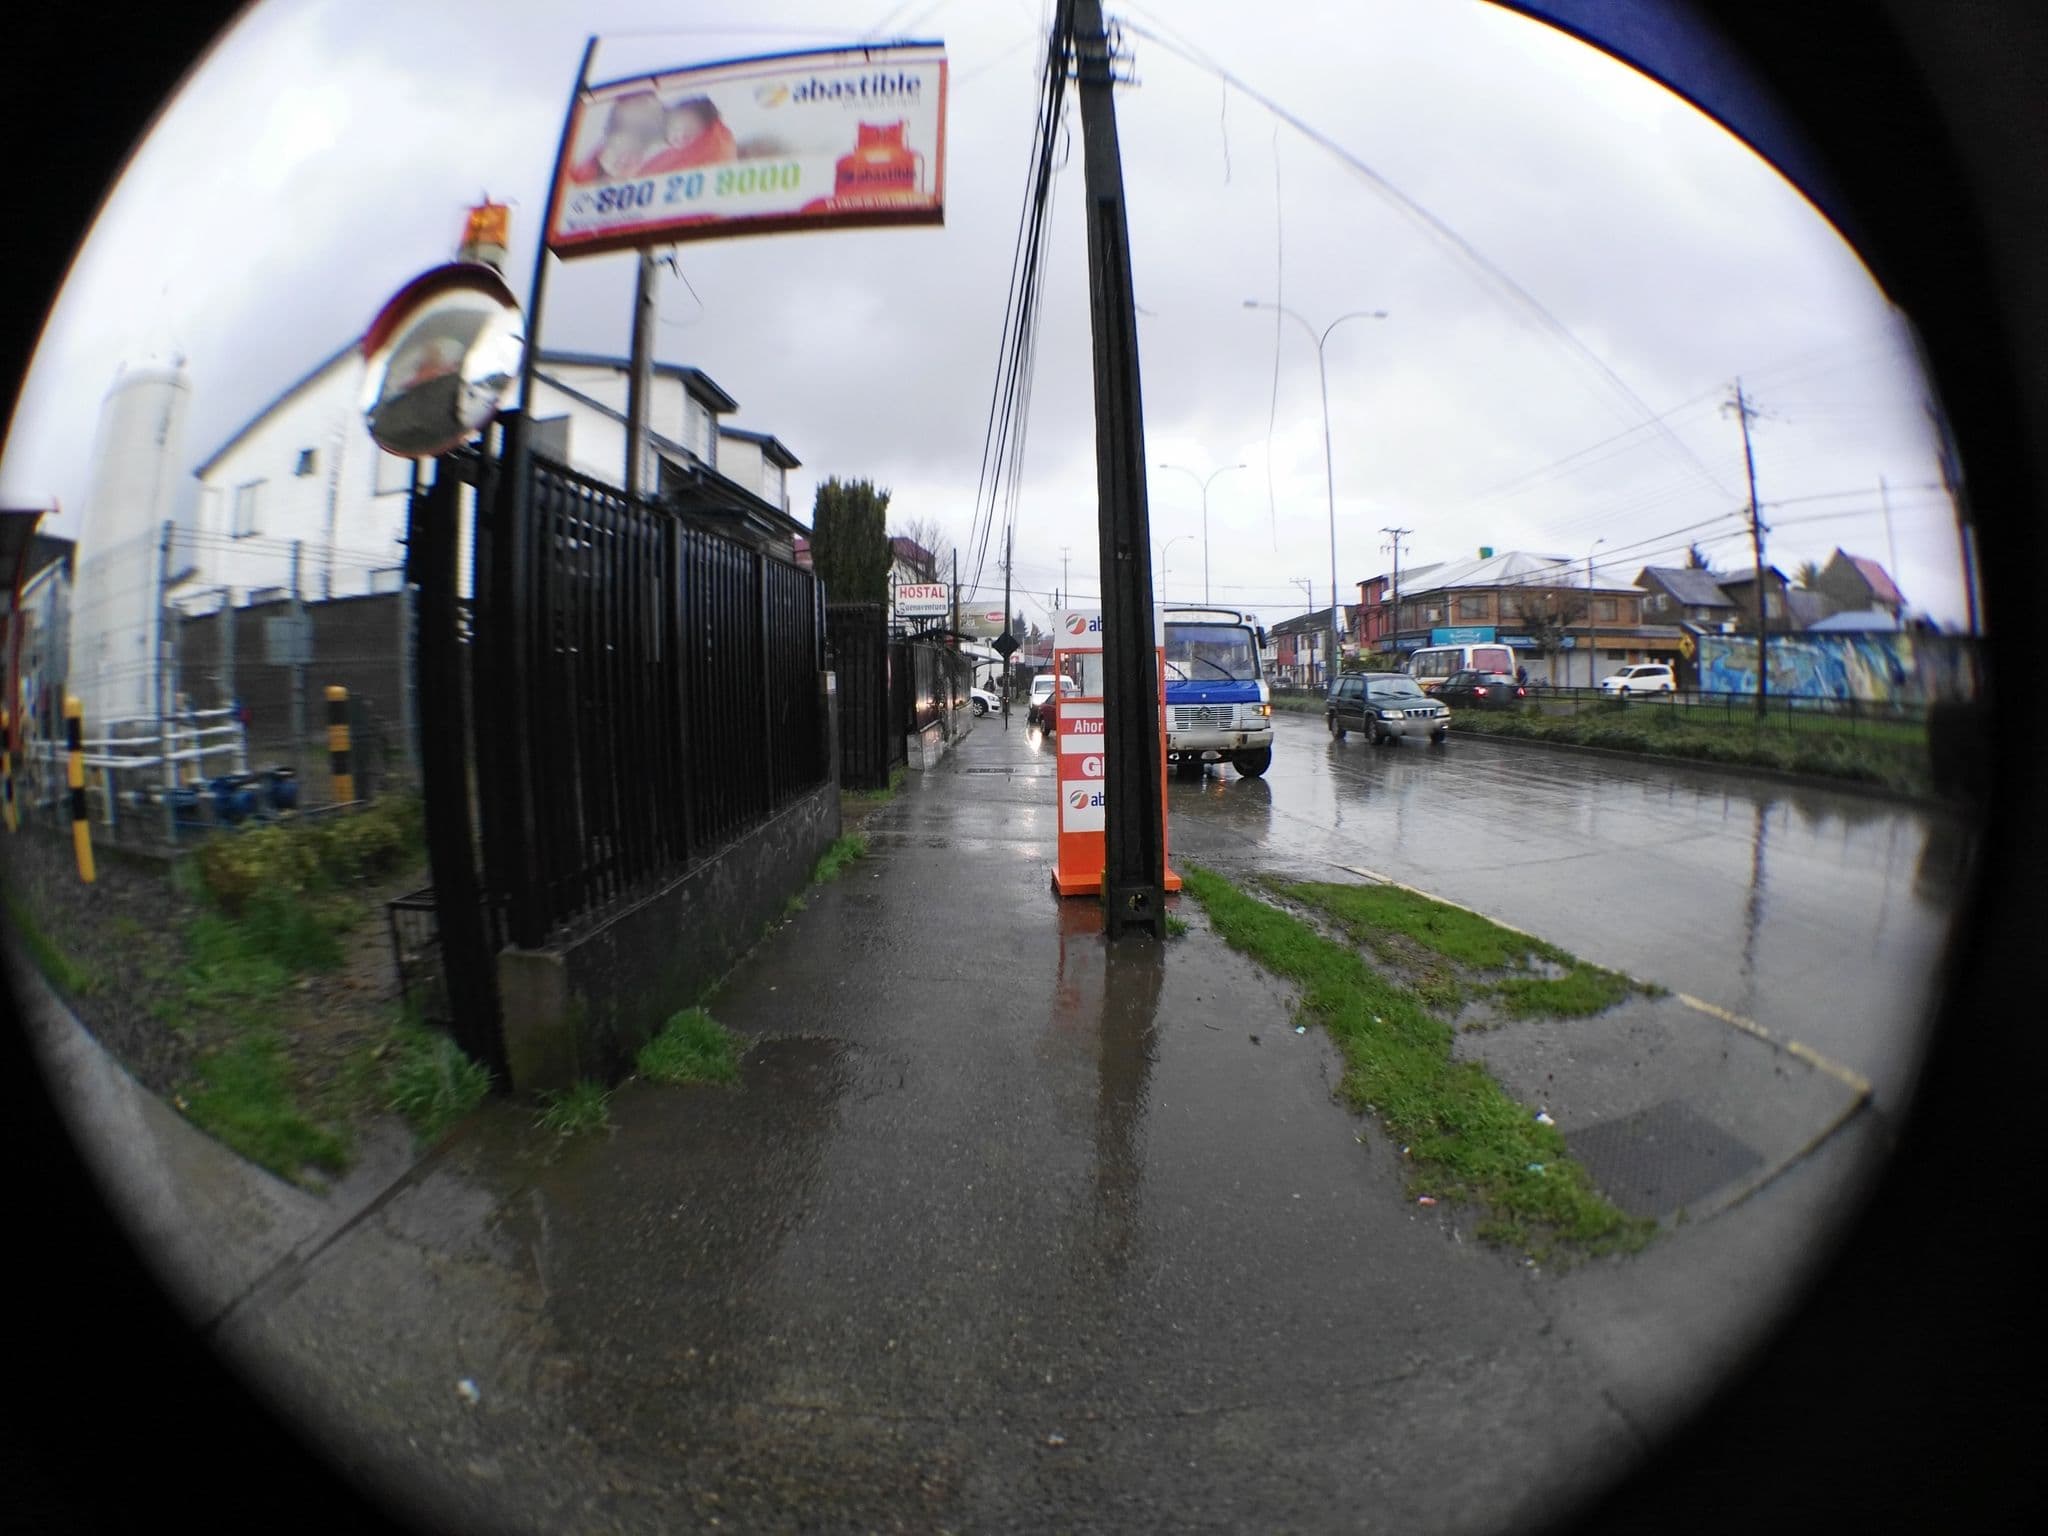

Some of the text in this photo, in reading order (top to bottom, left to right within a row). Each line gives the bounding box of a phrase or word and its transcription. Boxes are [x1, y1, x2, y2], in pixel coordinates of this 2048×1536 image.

[793, 73, 921, 102] abastible
[597, 179, 655, 213] 800
[664, 172, 704, 204] 20
[900, 586, 945, 599] HOSTAL
[896, 602, 946, 614] Buenaventura
